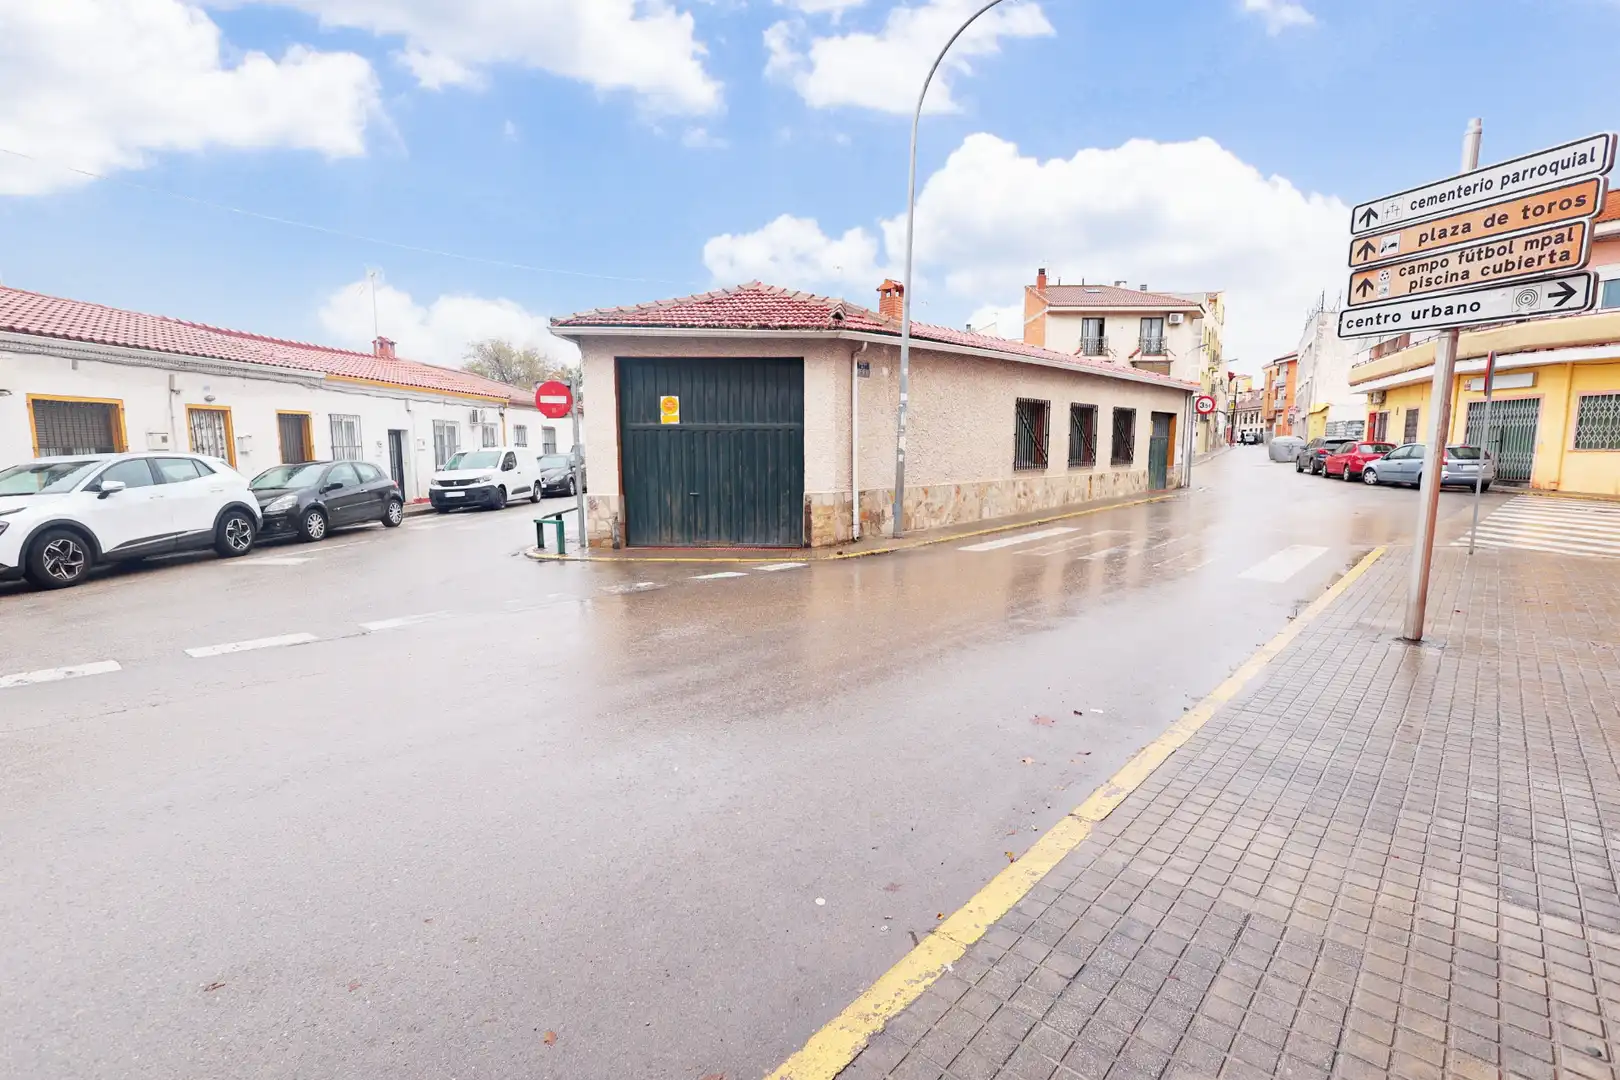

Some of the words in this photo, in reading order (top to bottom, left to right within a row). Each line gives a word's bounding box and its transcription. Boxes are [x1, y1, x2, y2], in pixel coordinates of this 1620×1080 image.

[1410, 177, 1494, 211] cementerio
[1500, 146, 1596, 190] parroquial
[1418, 221, 1472, 247] plaza
[1483, 212, 1509, 229] de
[1521, 192, 1588, 220] toros
[1398, 255, 1450, 278] campo
[1458, 240, 1515, 265] fútbol
[1523, 226, 1574, 255] mpal
[1408, 268, 1471, 293] piscina
[1480, 247, 1571, 277] cubierta
[1346, 311, 1402, 329] centro
[1410, 299, 1482, 320] urbano
